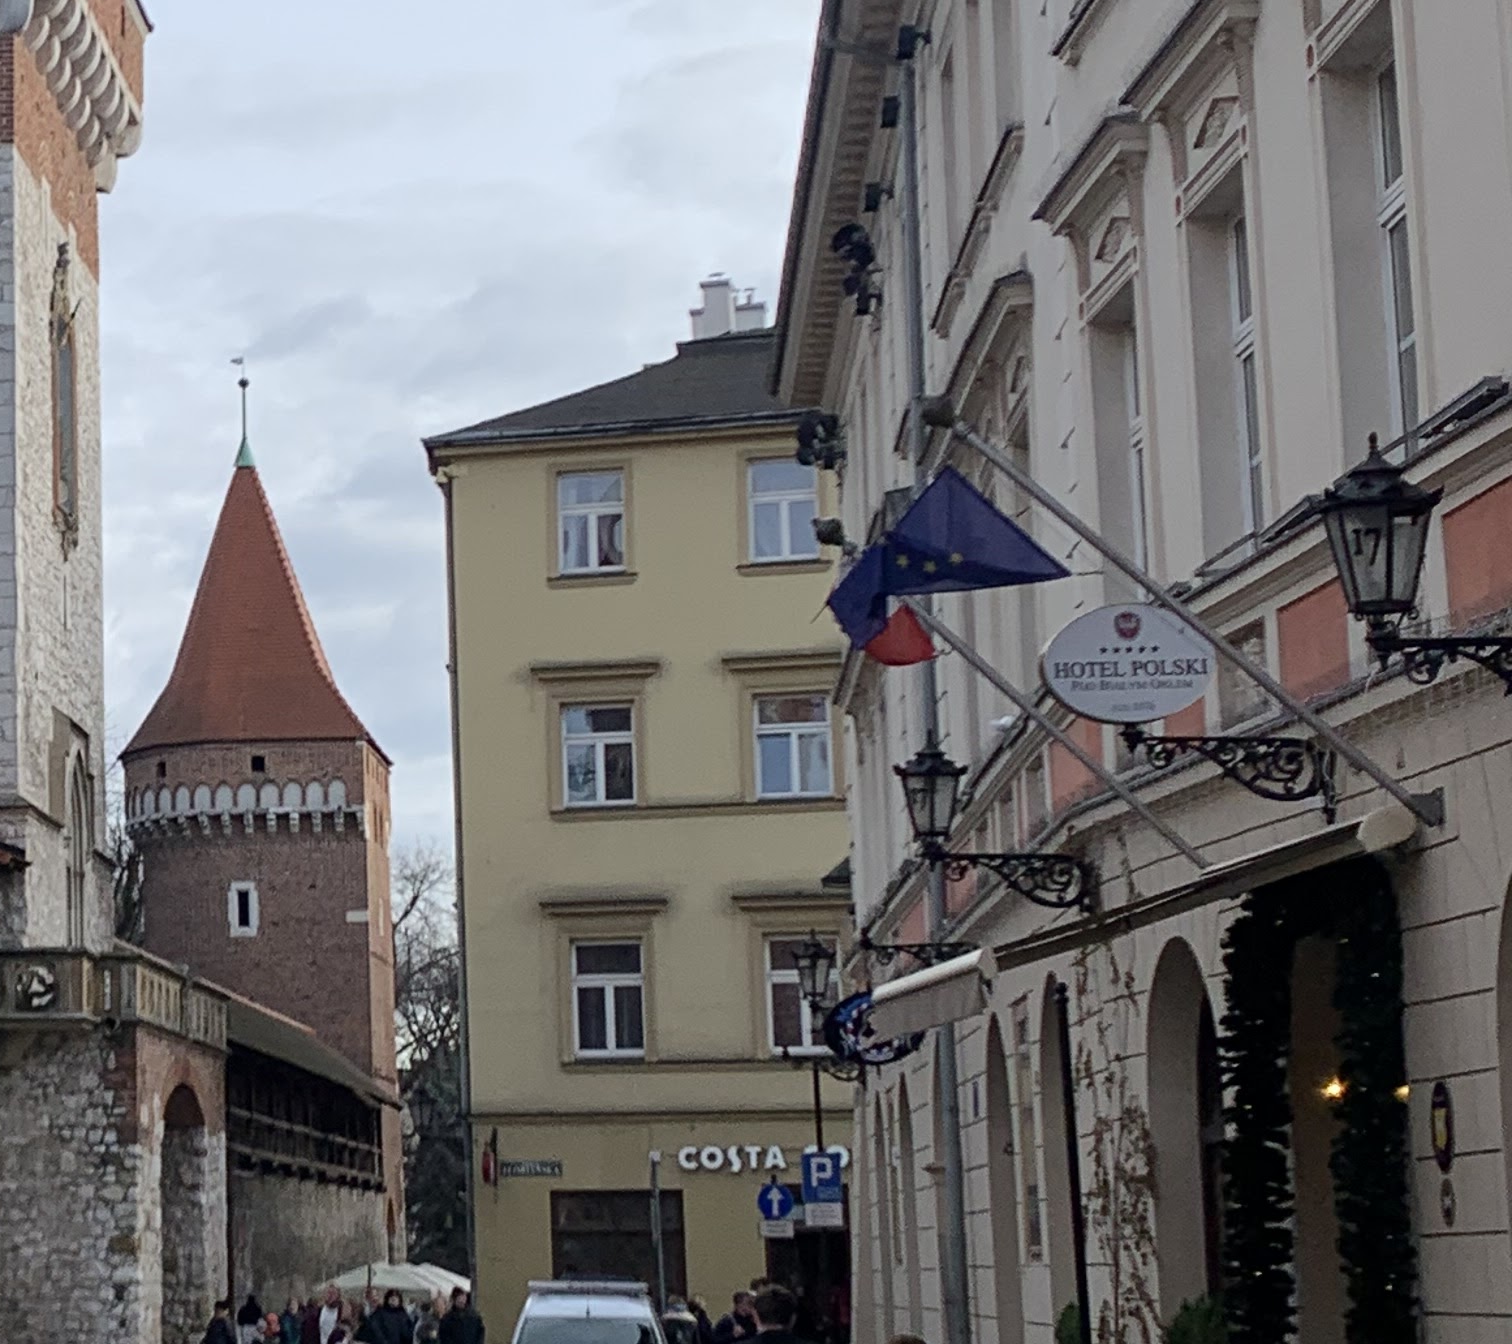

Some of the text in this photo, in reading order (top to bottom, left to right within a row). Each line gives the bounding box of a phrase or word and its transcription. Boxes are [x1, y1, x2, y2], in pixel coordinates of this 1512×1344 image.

[1053, 658, 1208, 679] HOTEL POLSKI
[678, 1145, 787, 1173] COSTA
[810, 1156, 833, 1188] P
